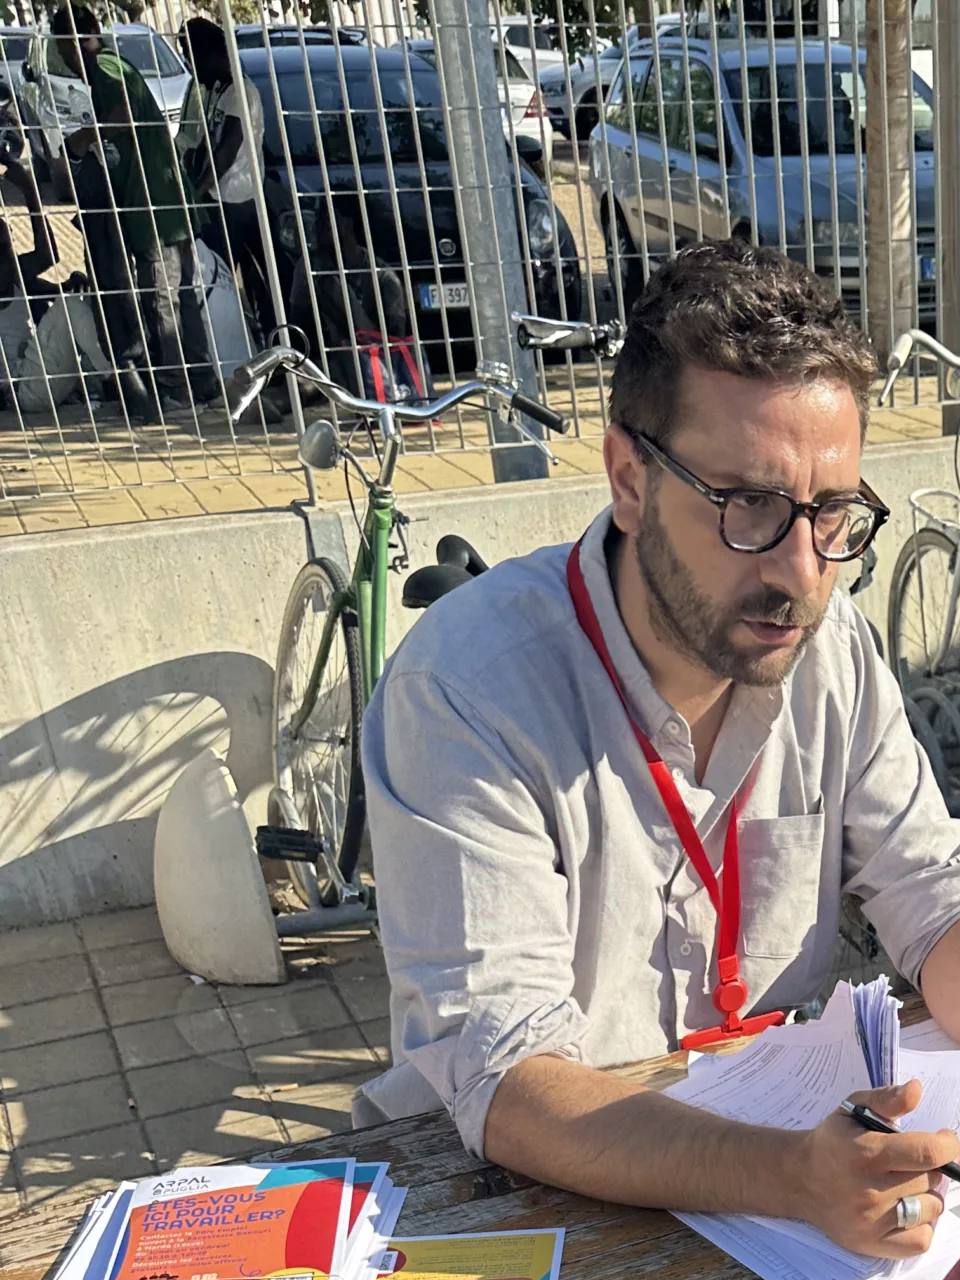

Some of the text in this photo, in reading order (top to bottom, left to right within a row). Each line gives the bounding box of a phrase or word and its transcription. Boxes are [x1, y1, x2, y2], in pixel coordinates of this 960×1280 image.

[153, 1176, 211, 1190] ARPAL
[162, 1184, 209, 1195] PUGLIA
[147, 1192, 266, 1213] ÊTES-VOUS
[141, 1209, 286, 1233] TRAVAILLER?
[143, 1204, 235, 1223] ICI POUR
